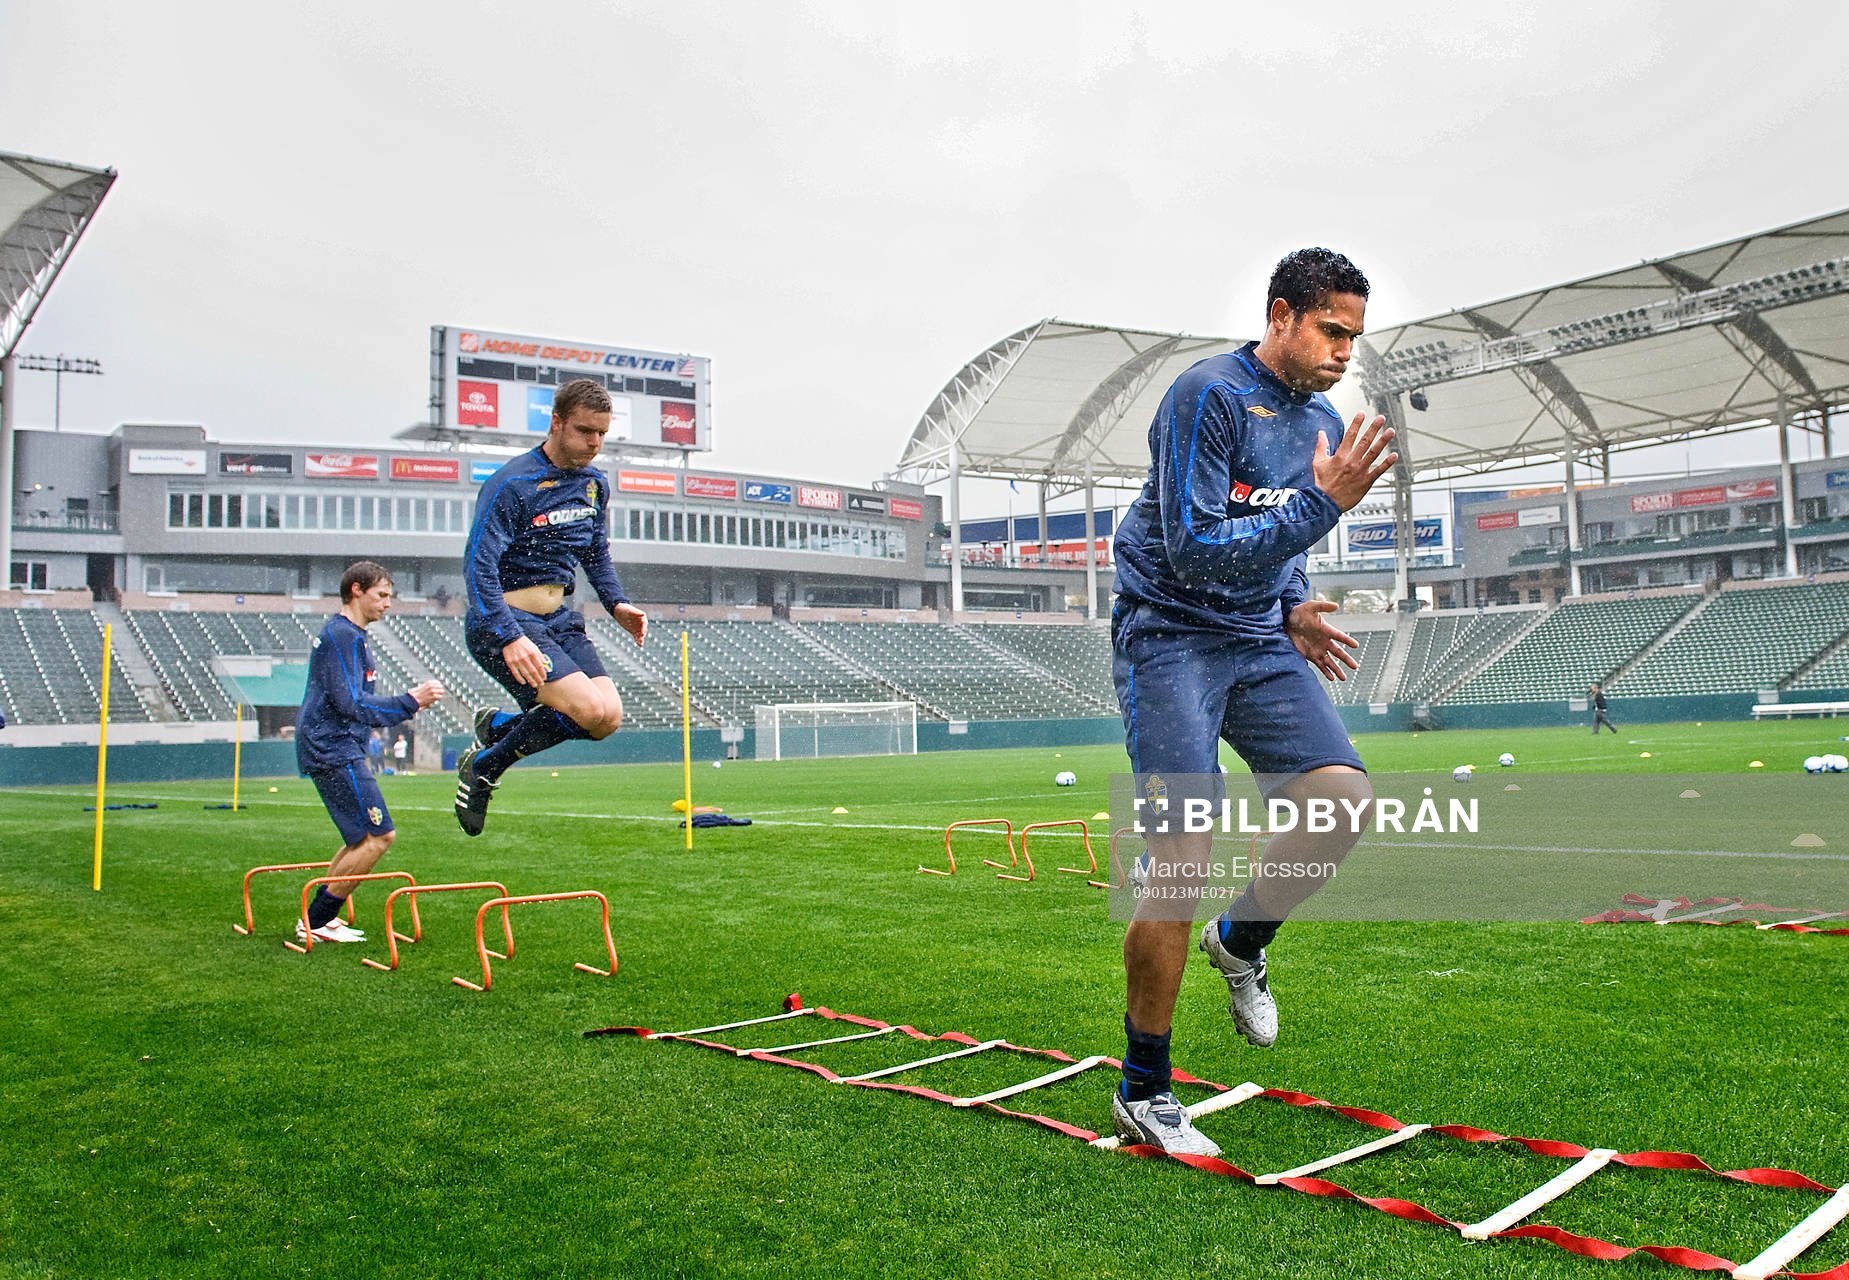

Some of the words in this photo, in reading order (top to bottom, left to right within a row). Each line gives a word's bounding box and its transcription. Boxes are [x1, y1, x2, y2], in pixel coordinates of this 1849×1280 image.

[482, 338, 540, 357] HOME
[540, 346, 605, 365] DEPOT
[603, 352, 675, 373] CENTER
[461, 402, 494, 413] TOYOTA
[661, 414, 694, 429] Bud
[801, 487, 839, 502] SPORTS
[1351, 529, 1388, 543] BUD
